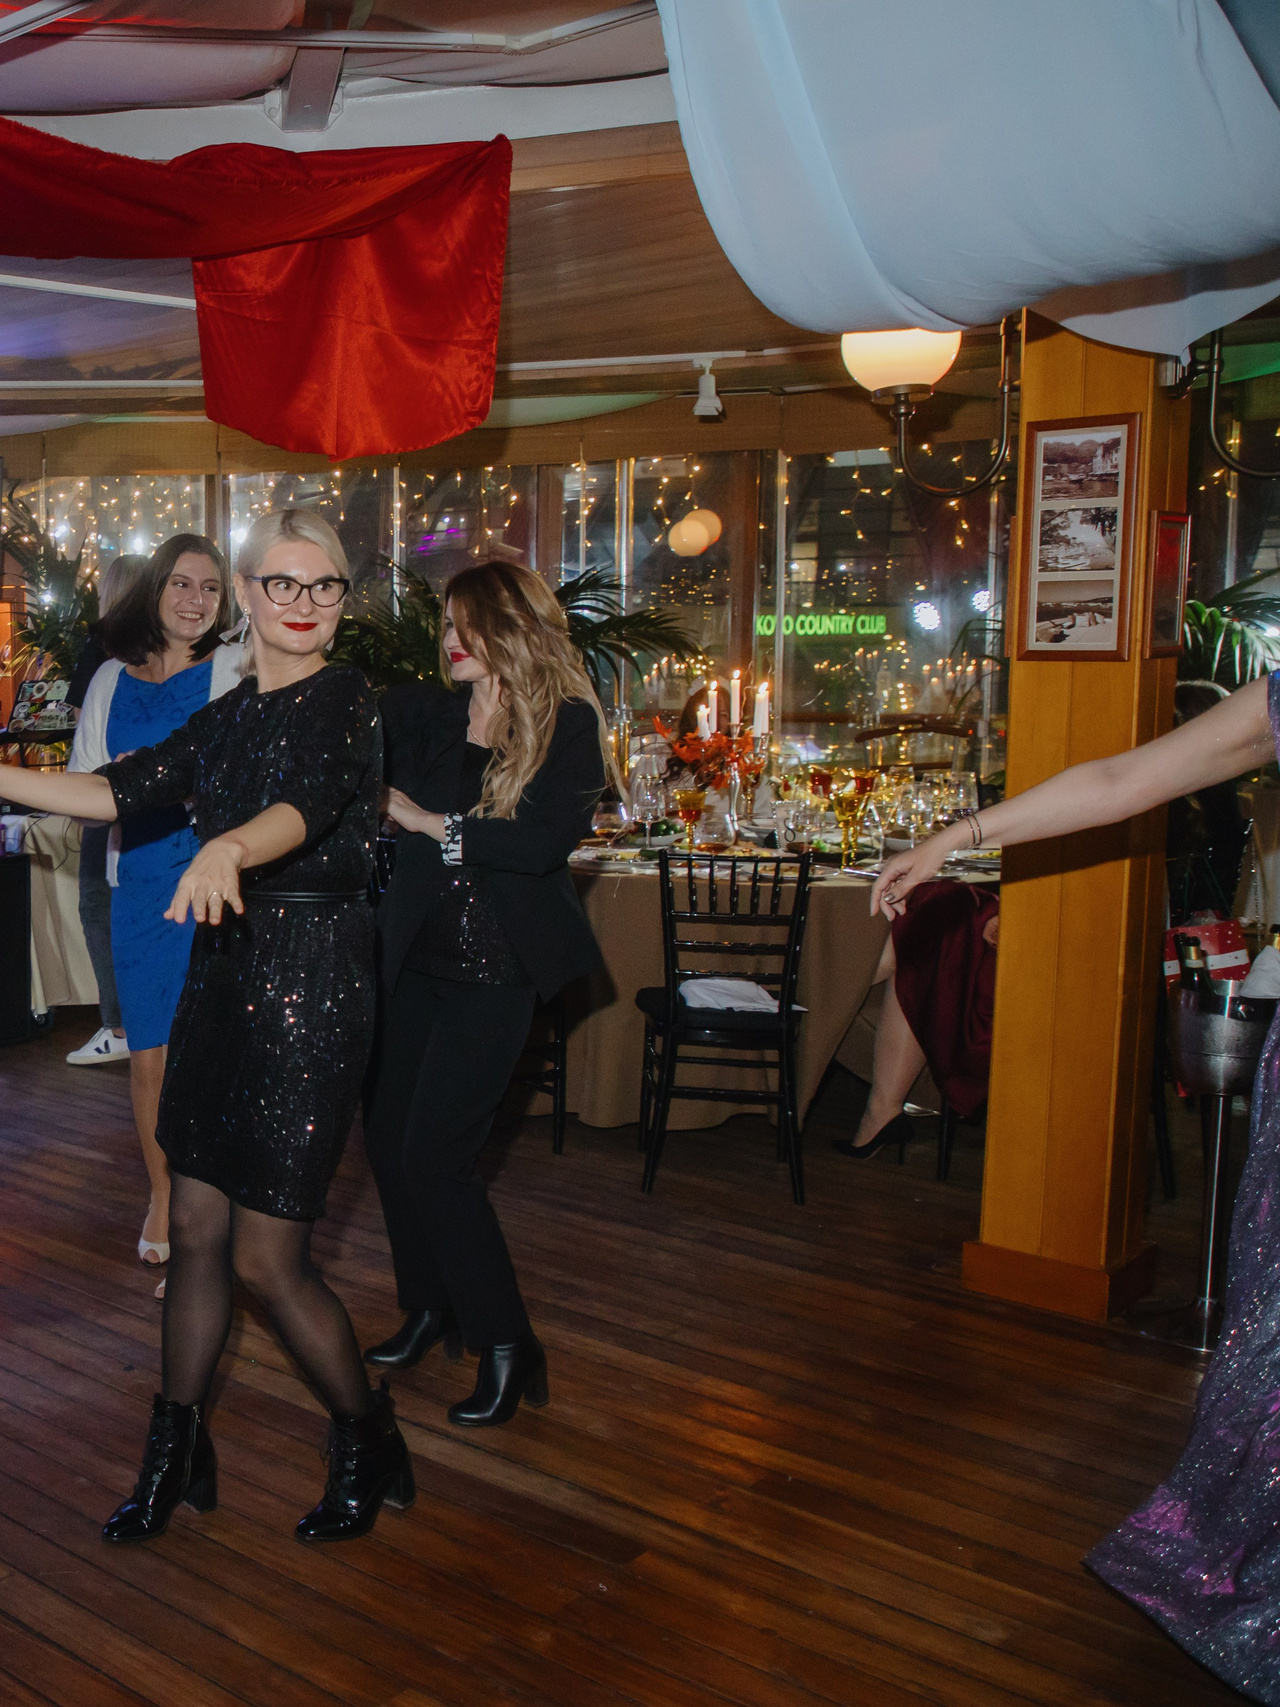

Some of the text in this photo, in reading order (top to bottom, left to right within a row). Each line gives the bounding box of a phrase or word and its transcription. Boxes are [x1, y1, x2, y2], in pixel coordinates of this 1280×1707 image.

[755, 614, 886, 636] KOO COUNTRY CLUB
